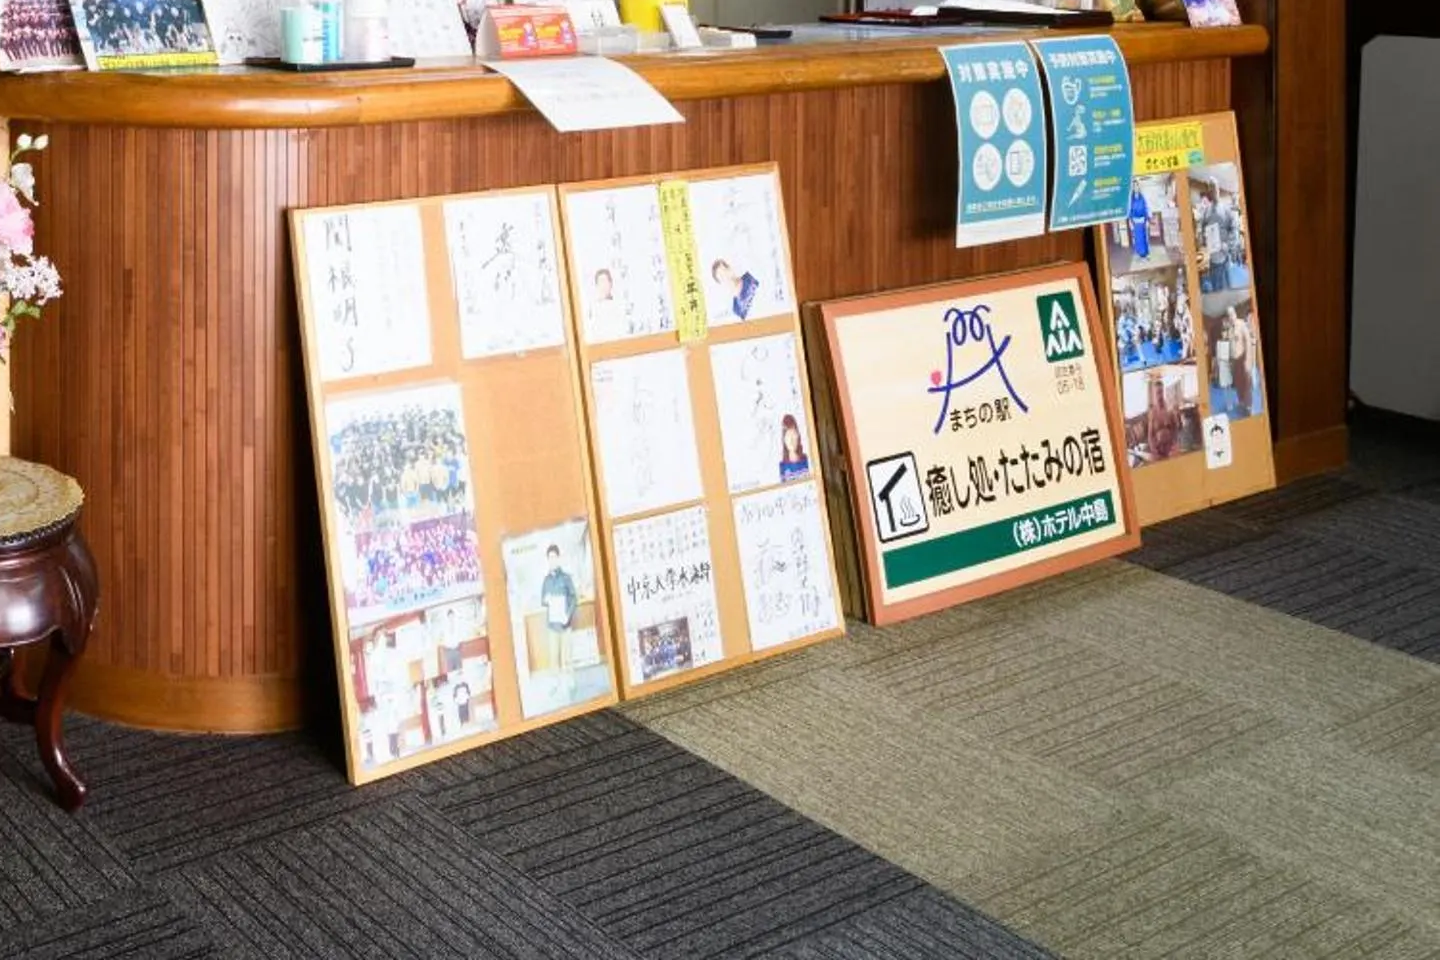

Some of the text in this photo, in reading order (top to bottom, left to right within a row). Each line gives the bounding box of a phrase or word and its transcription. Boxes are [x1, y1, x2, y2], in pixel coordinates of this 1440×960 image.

[949, 396, 1013, 432] まちの駅
[925, 426, 1106, 518] 癒し処・たたみの宿
[1013, 501, 1109, 547] (株)ホテル中島
